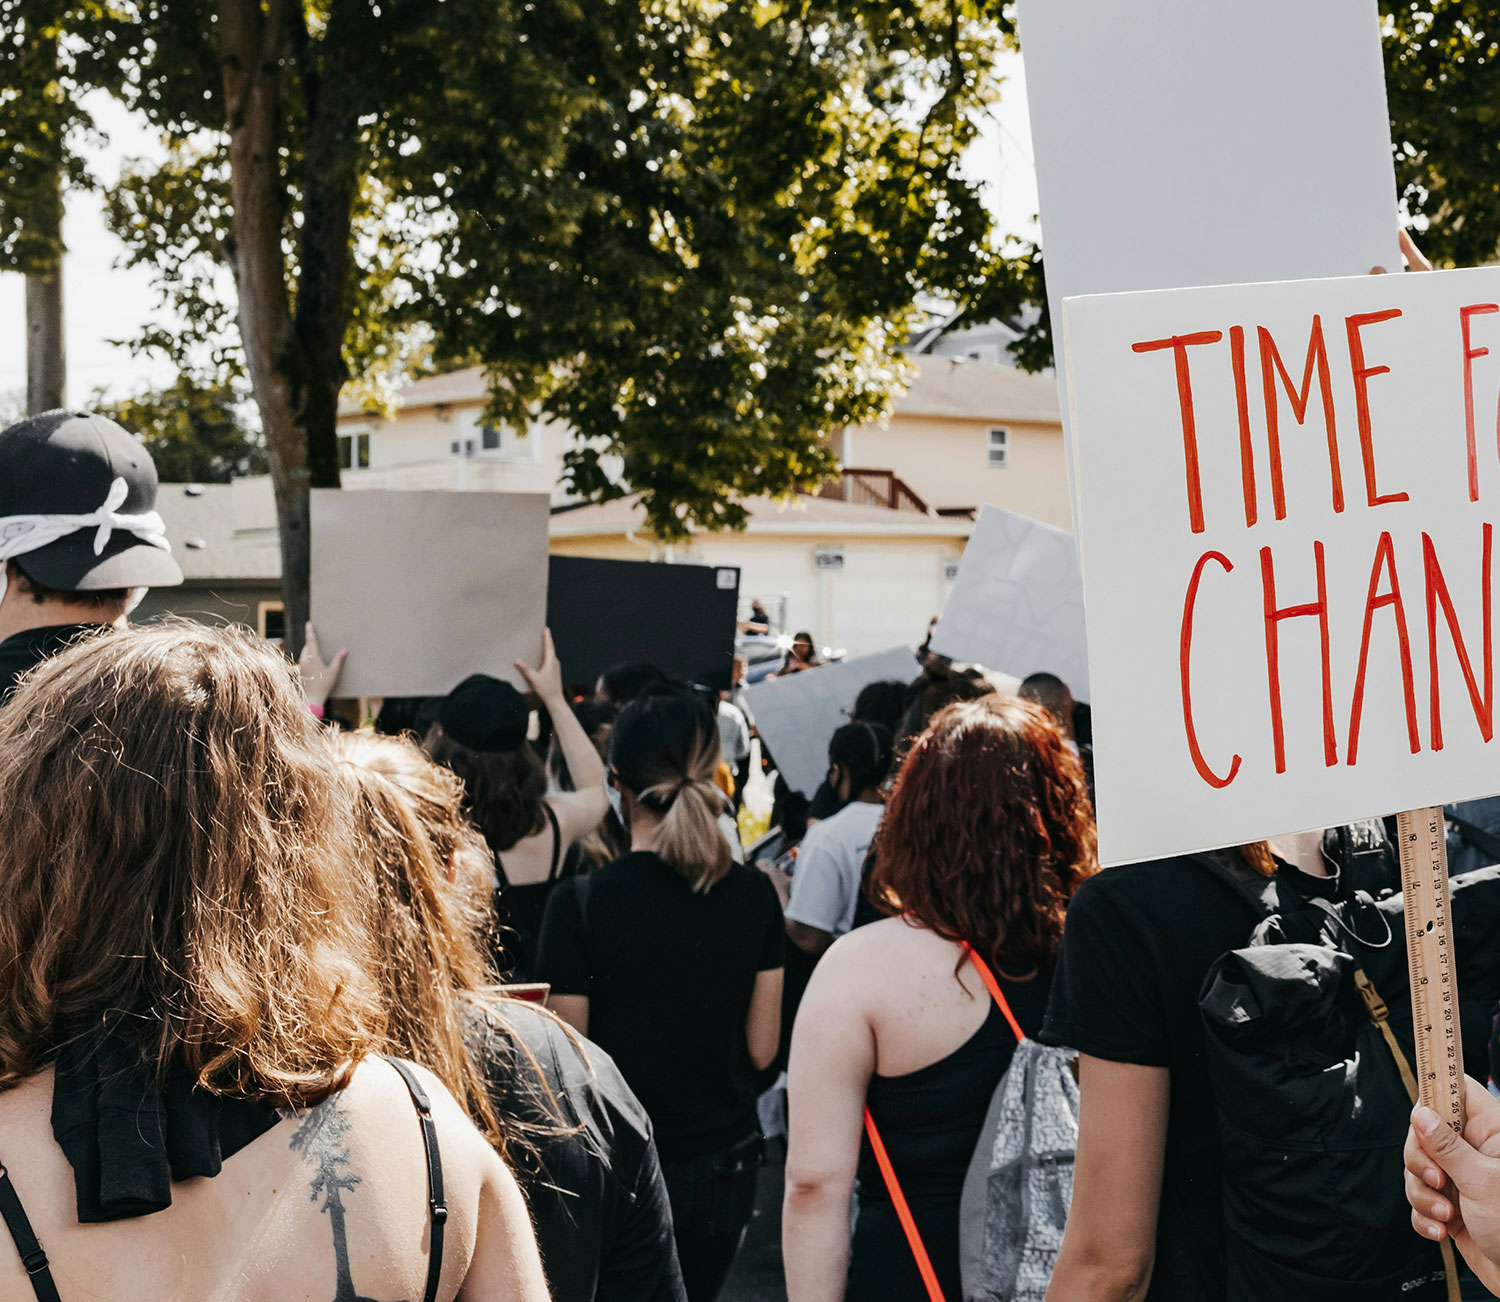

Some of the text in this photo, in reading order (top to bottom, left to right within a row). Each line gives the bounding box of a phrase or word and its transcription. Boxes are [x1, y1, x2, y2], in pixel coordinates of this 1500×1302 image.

[1132, 308, 1410, 534] TIME
[1408, 833, 1417, 842] 8
[1412, 881, 1421, 890] 7
[1429, 821, 1461, 1133] 10 11 12 13 14 15 16 17 18 19 20 21 22 23 24 25 26
[1424, 1024, 1433, 1033] 4
